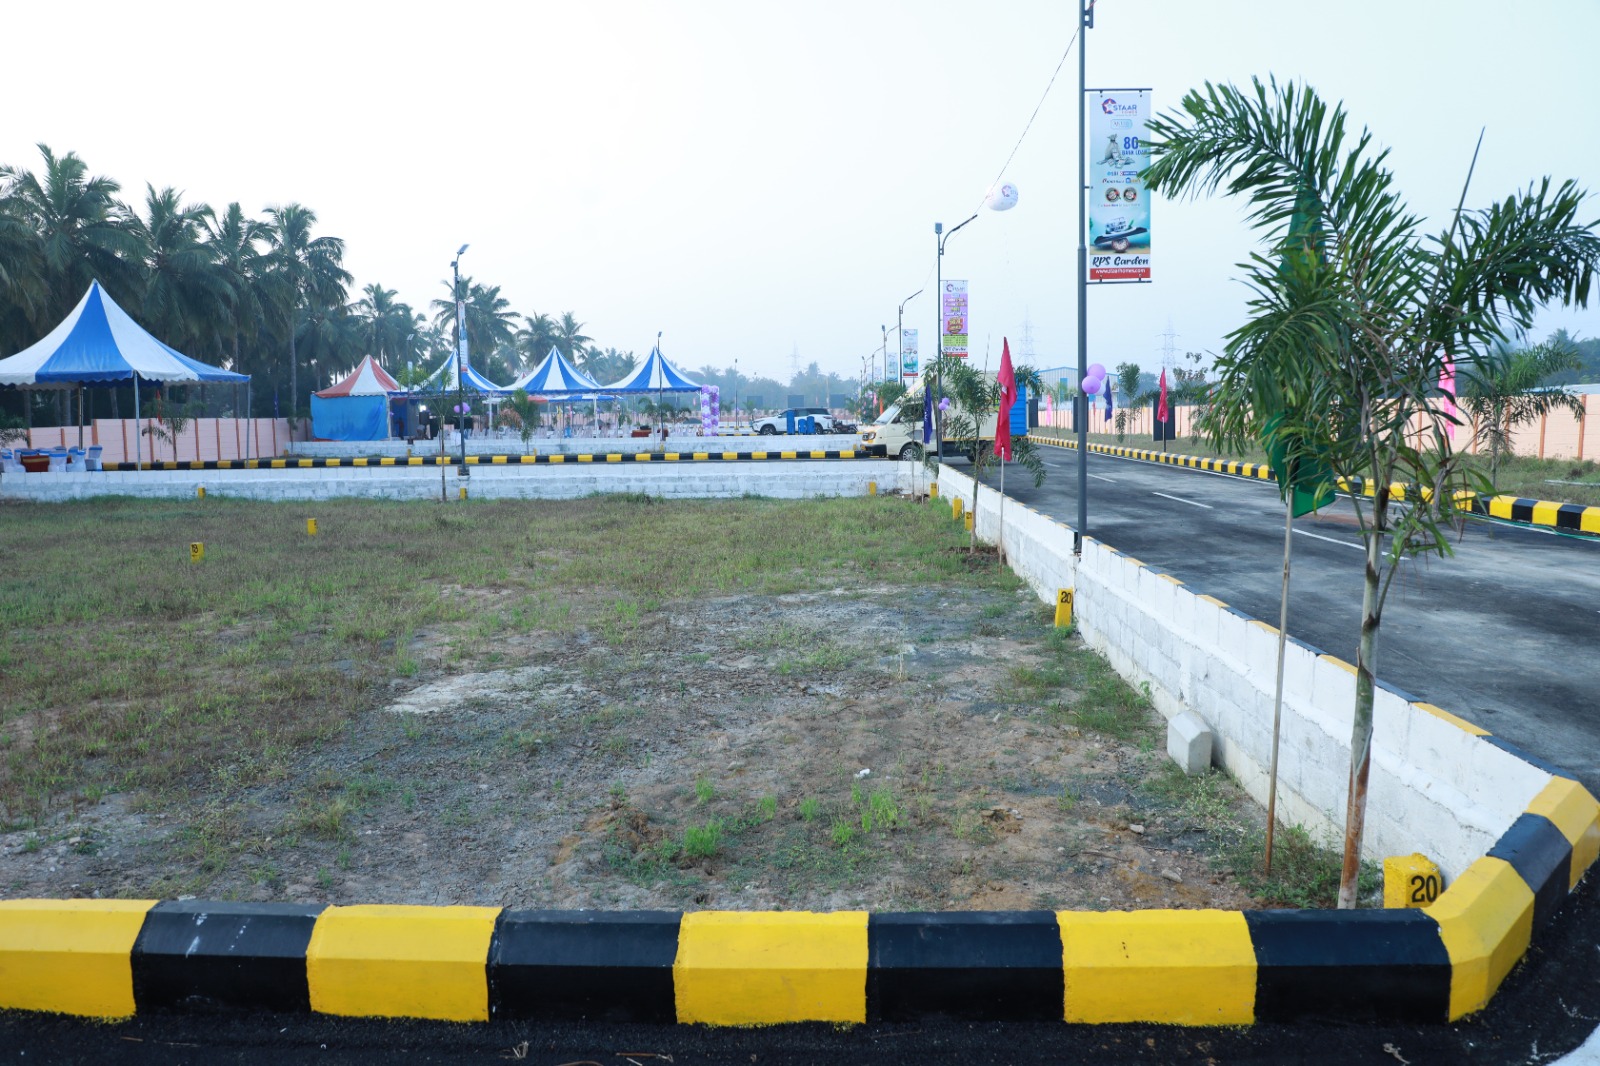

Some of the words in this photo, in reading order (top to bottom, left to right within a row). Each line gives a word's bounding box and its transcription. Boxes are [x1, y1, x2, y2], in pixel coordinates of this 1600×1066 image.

[1123, 136, 1139, 149] 80
[1093, 256, 1111, 267] RPS
[1114, 256, 1149, 266] Garden
[1060, 591, 1072, 604] 20
[1411, 875, 1438, 903] 20
